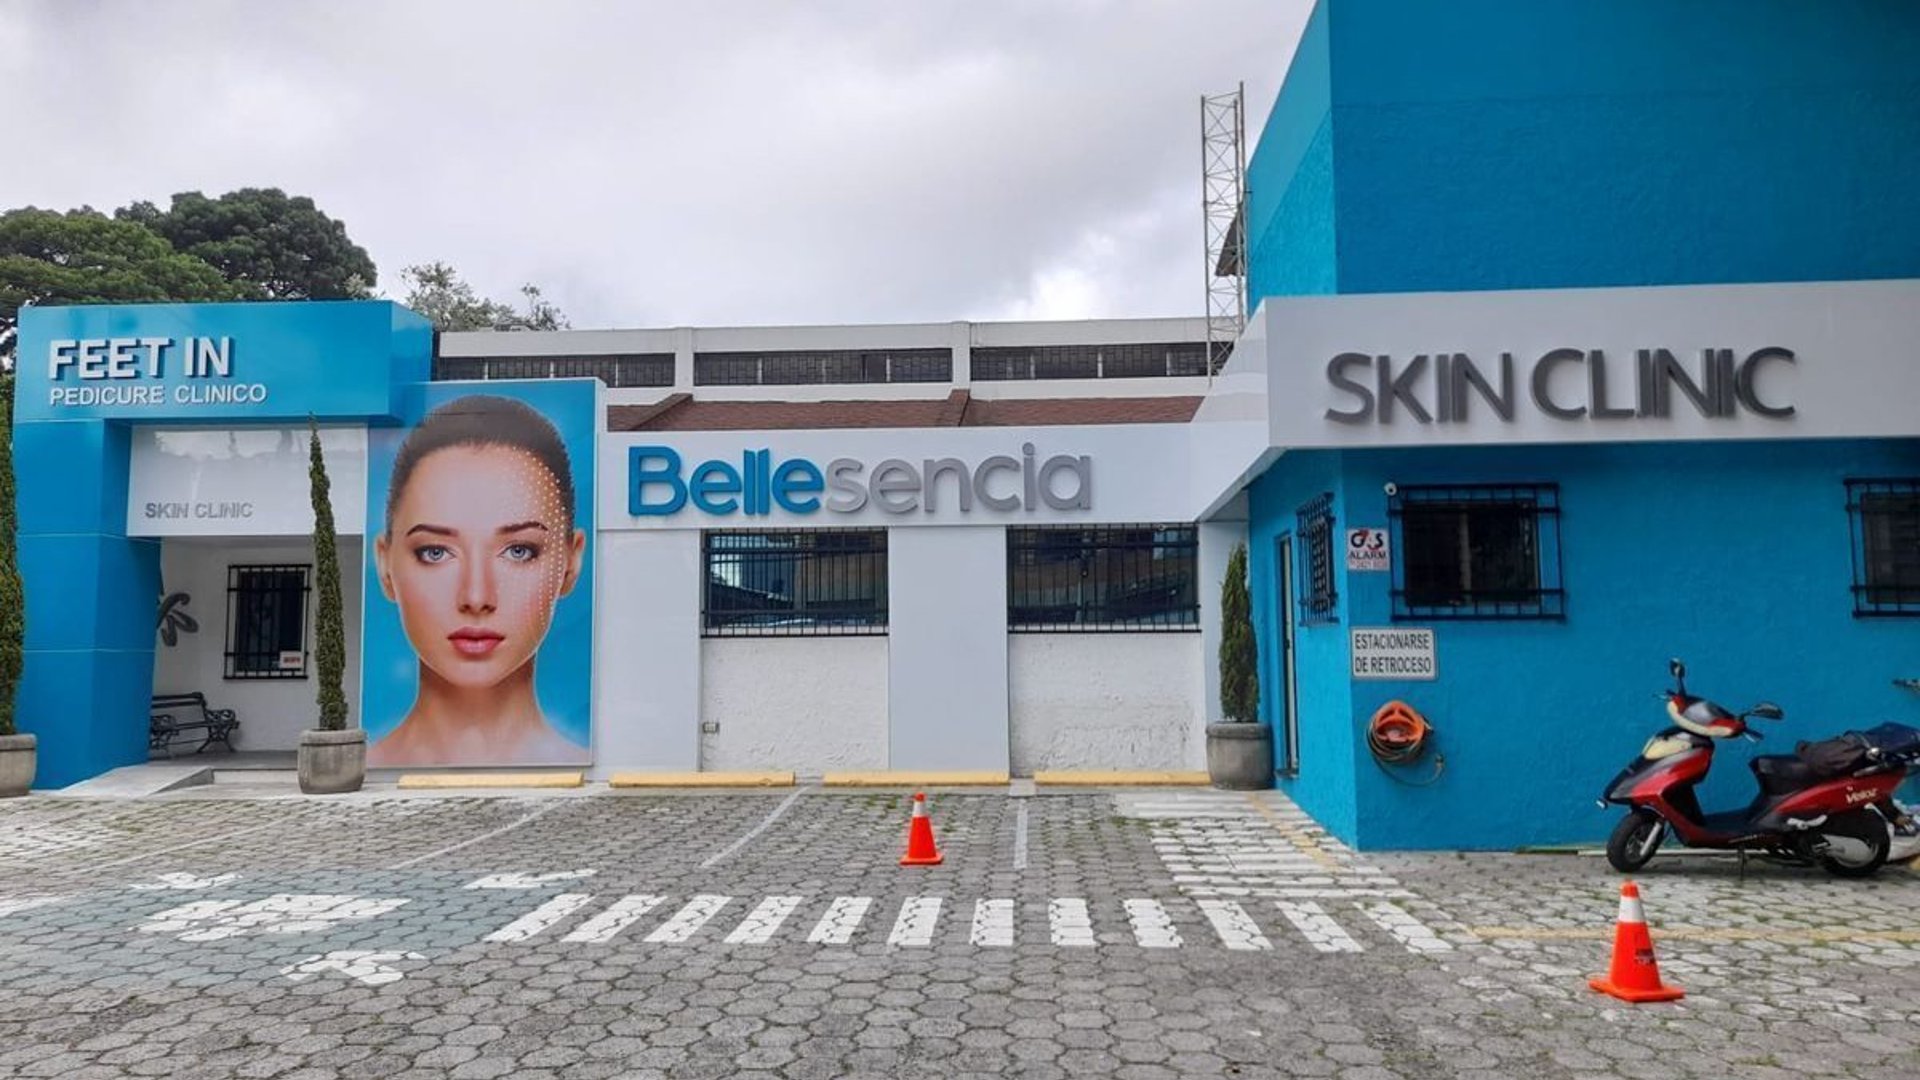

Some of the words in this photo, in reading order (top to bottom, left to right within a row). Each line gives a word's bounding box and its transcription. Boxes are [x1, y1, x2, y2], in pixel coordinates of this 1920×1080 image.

[49, 338, 173, 380] FEET
[185, 336, 233, 377] IN
[50, 386, 165, 405] PEDICURE
[175, 383, 267, 403] CLINICO
[1325, 352, 1514, 425] SKIN
[1530, 346, 1796, 421] CLINIC
[628, 442, 1093, 517] Bellesencia
[145, 502, 189, 518] SKIN
[195, 502, 253, 518] CLINIC
[1350, 551, 1386, 560] ALARM
[1355, 633, 1430, 649] ESTACIONARSE
[1355, 656, 1368, 673] DE
[1370, 656, 1431, 673] RETROCESO
